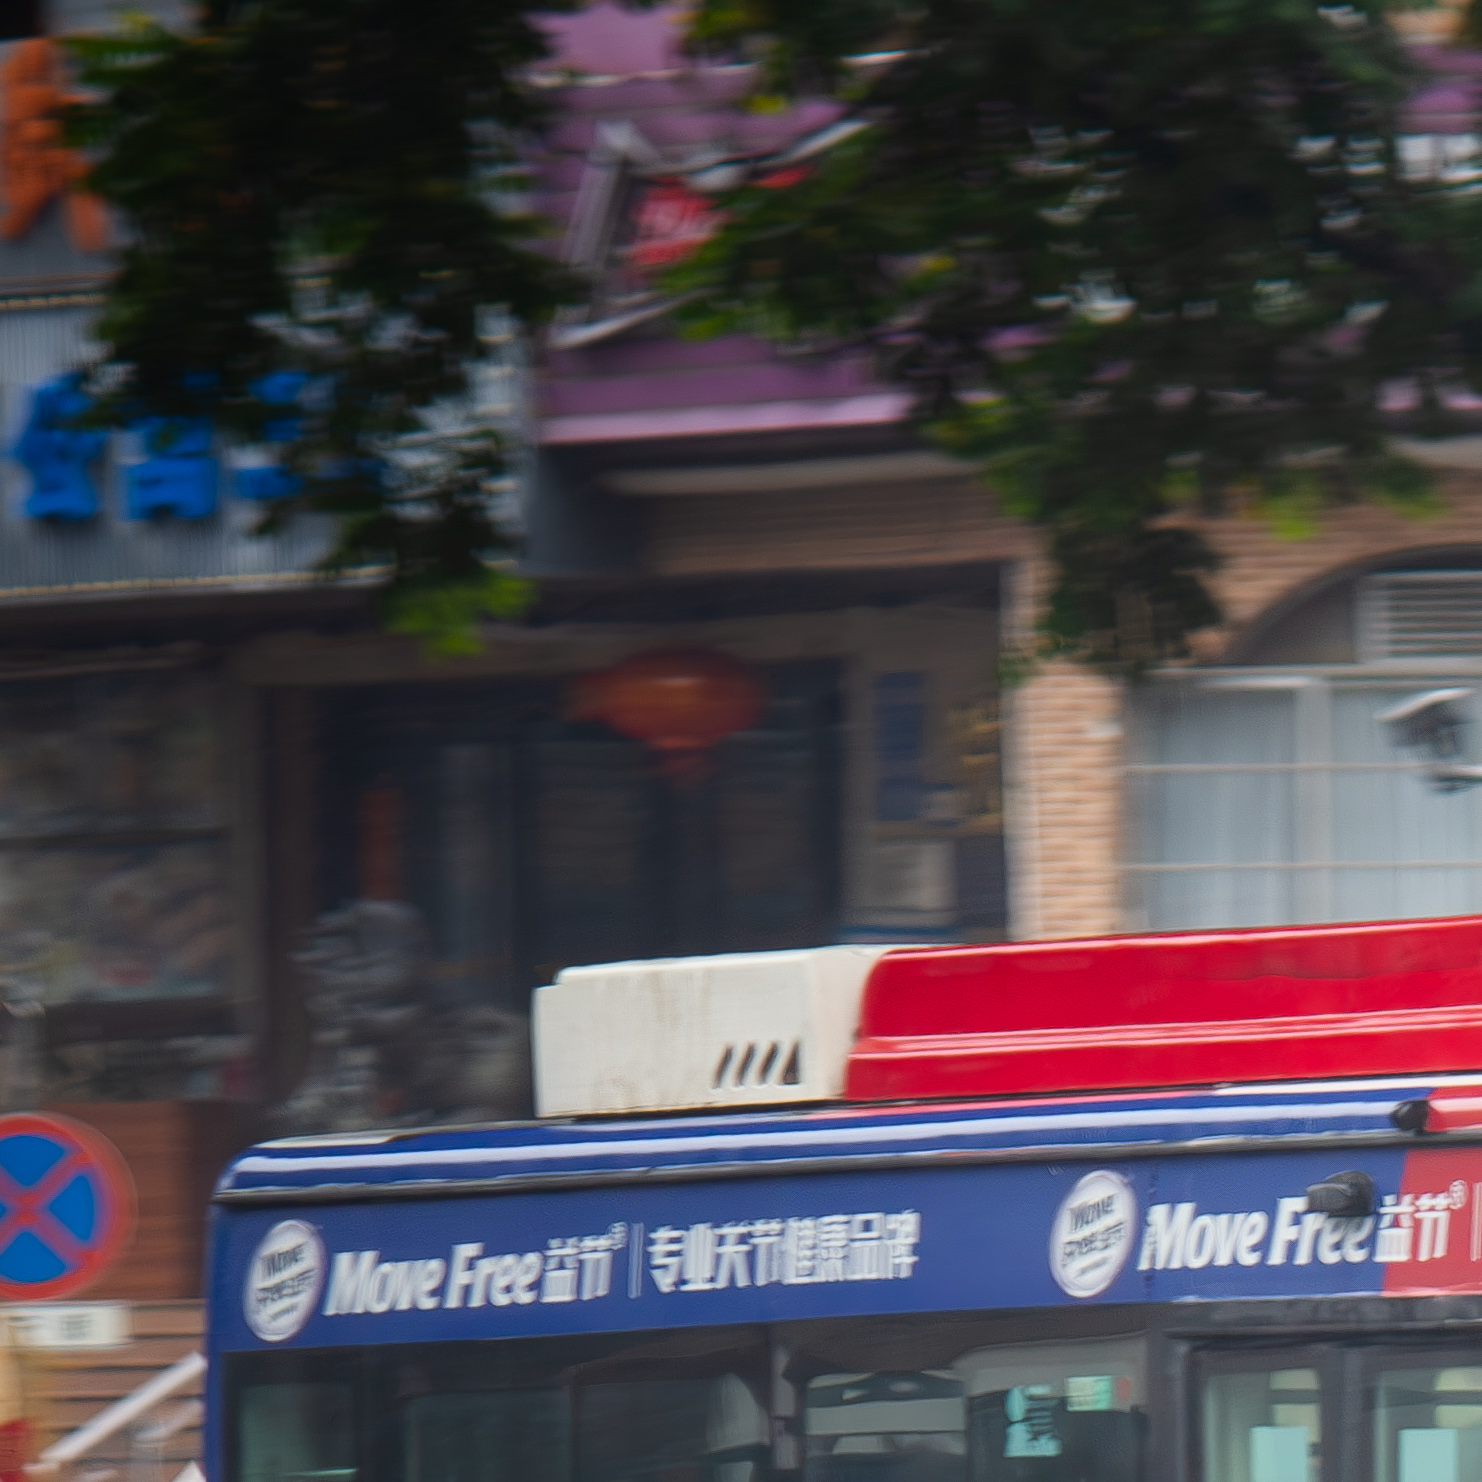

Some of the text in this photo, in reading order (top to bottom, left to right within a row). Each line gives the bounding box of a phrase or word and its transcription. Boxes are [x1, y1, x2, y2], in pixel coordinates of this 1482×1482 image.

[322, 1250, 446, 1315] Move
[444, 1241, 543, 1308] Free
[648, 1209, 921, 1293] 专业关节健康品牌
[1137, 1202, 1268, 1270] Move
[1266, 1195, 1376, 1265] Free
